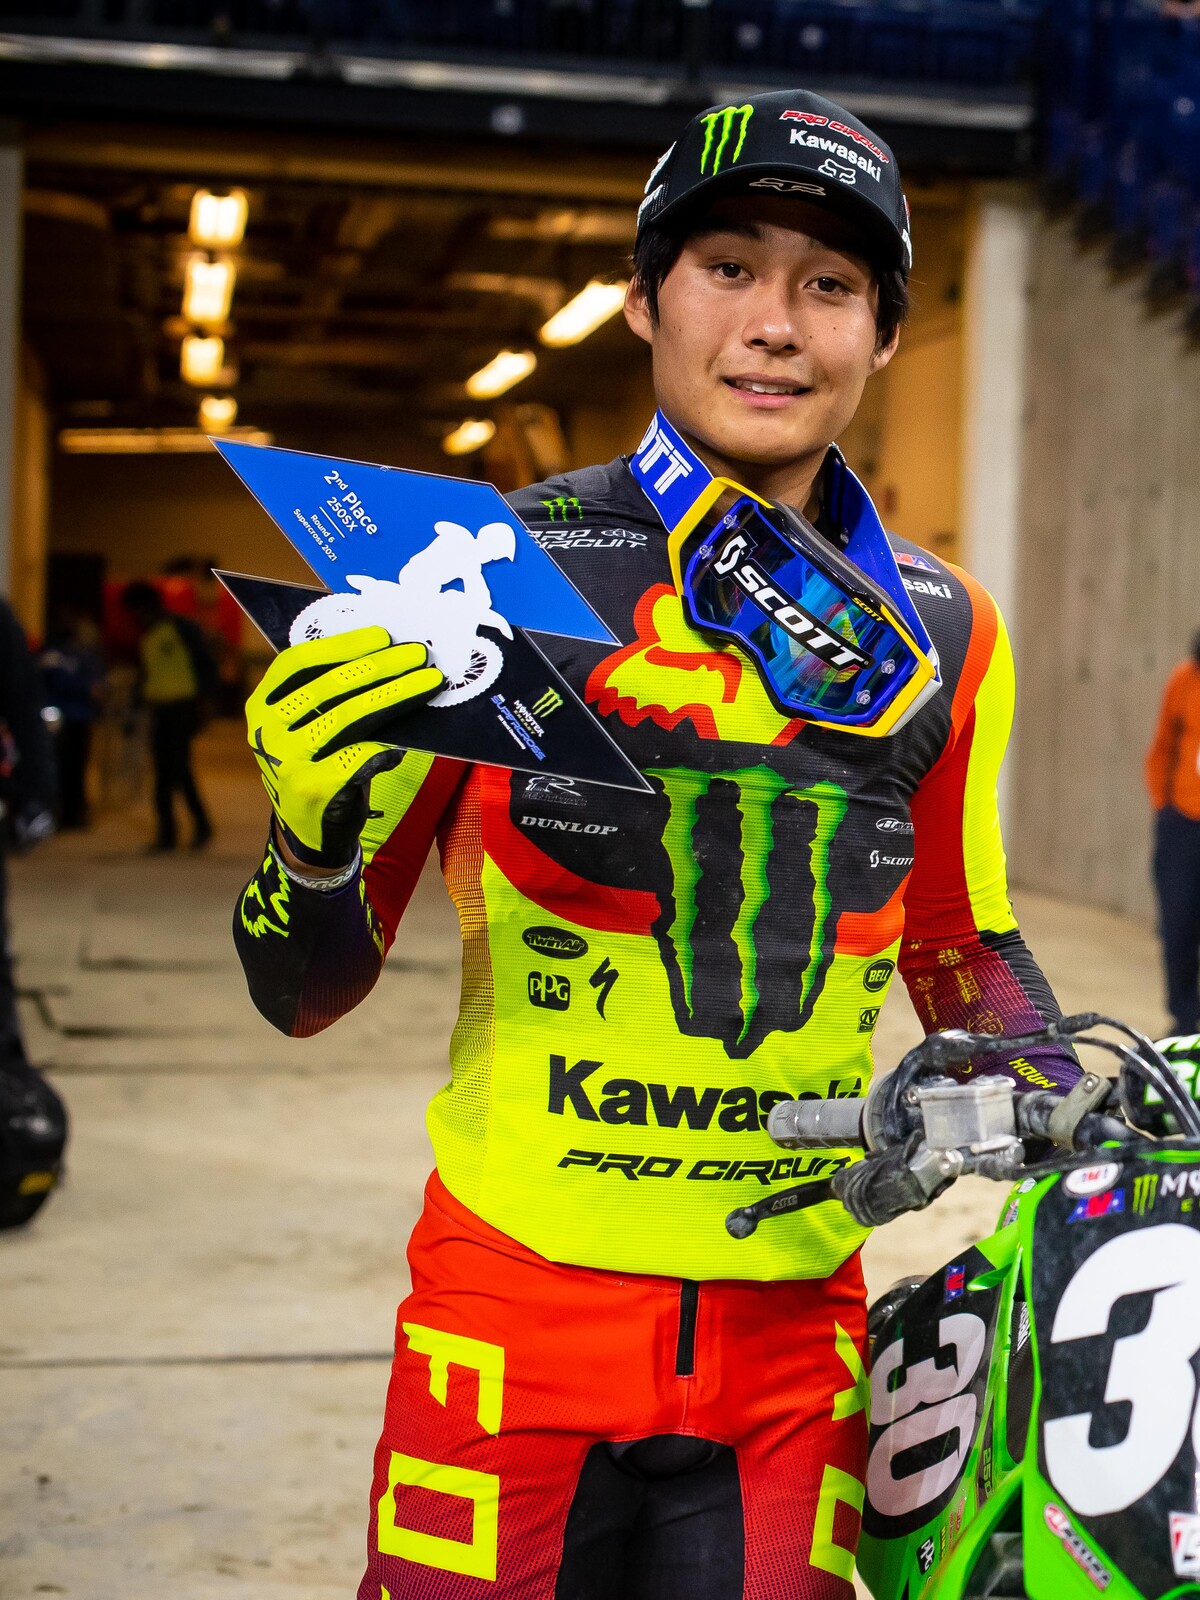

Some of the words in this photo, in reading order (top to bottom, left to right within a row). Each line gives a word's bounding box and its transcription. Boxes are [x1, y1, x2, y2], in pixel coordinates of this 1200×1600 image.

[779, 110, 828, 127] PRO
[827, 119, 889, 164] CIRCUIT
[789, 128, 882, 183] Kawasaki
[323, 470, 349, 491] 2nd
[342, 491, 378, 535] Place
[326, 496, 359, 532] 250SX
[293, 508, 324, 546] Supercross
[321, 544, 338, 562] 2021
[310, 514, 331, 538] Round
[736, 560, 869, 670] SCOTT
[852, 597, 885, 622] SCOTT
[519, 814, 619, 836] DUNLOP
[880, 855, 915, 866] SCOTT
[529, 971, 569, 1003] PPG
[867, 969, 891, 983] BELL
[557, 1148, 682, 1181] PRO
[686, 1156, 852, 1186] CIRCUIT
[866, 1312, 986, 1517] 30
